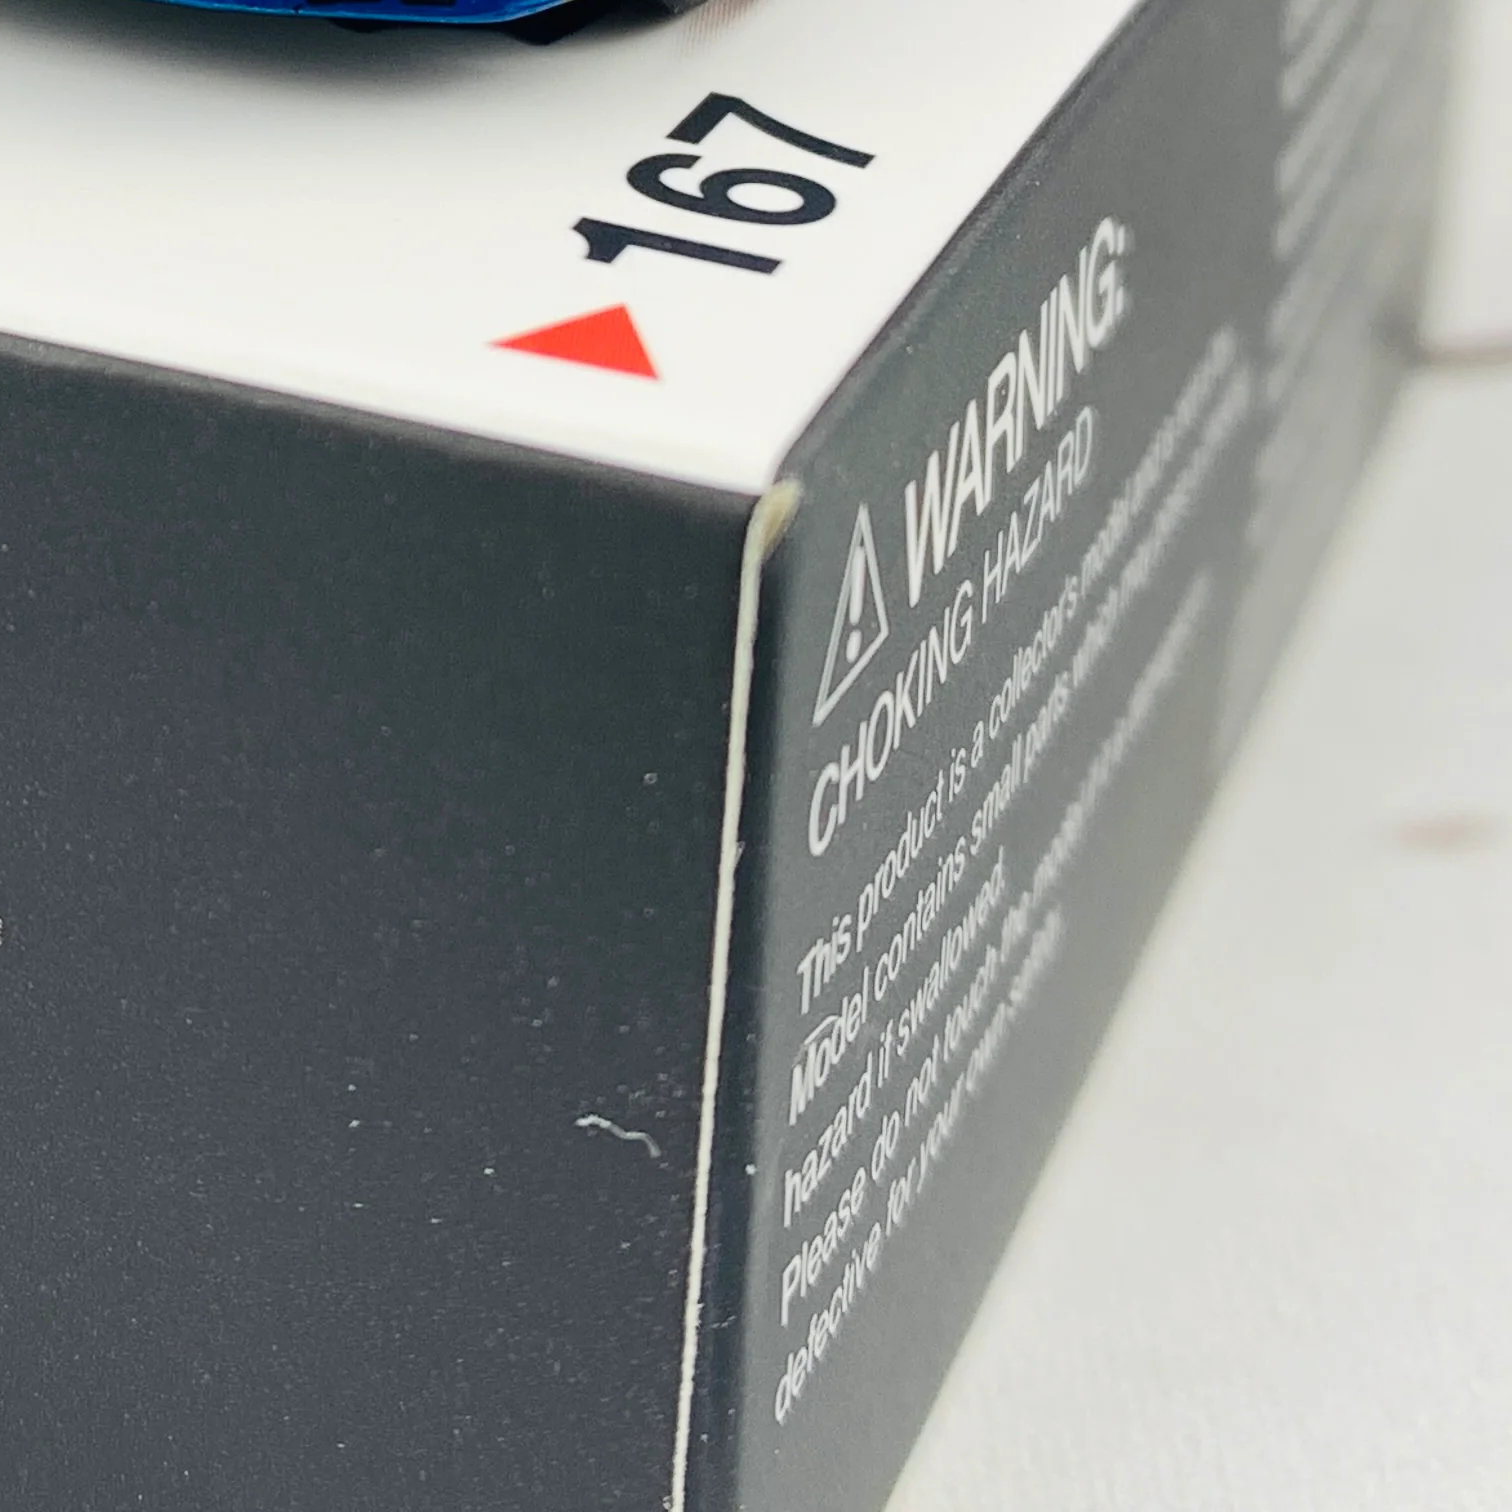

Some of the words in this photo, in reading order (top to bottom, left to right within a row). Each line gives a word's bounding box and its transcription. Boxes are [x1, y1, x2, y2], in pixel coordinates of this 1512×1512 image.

[571, 91, 876, 275] 167
[796, 913, 852, 1016] This
[855, 768, 944, 953] product
[948, 747, 967, 803] is
[970, 720, 985, 769] a
[989, 574, 1078, 741] collector's
[808, 580, 973, 857] CHOKING
[981, 405, 1094, 624] HAZARD
[784, 1051, 873, 1229] hazard
[876, 1018, 895, 1089] if
[897, 844, 1006, 1058] swallowed.
[790, 965, 869, 1126] Model
[874, 836, 967, 1002] contains
[969, 732, 1022, 857] small
[1024, 671, 1069, 784] parts
[774, 1222, 883, 1426] defective
[885, 1155, 918, 1237] for
[918, 1070, 967, 1194] your
[780, 1166, 867, 1328] Please
[870, 1110, 901, 1182] do
[904, 1034, 941, 1128] not
[943, 944, 998, 1064] touch
